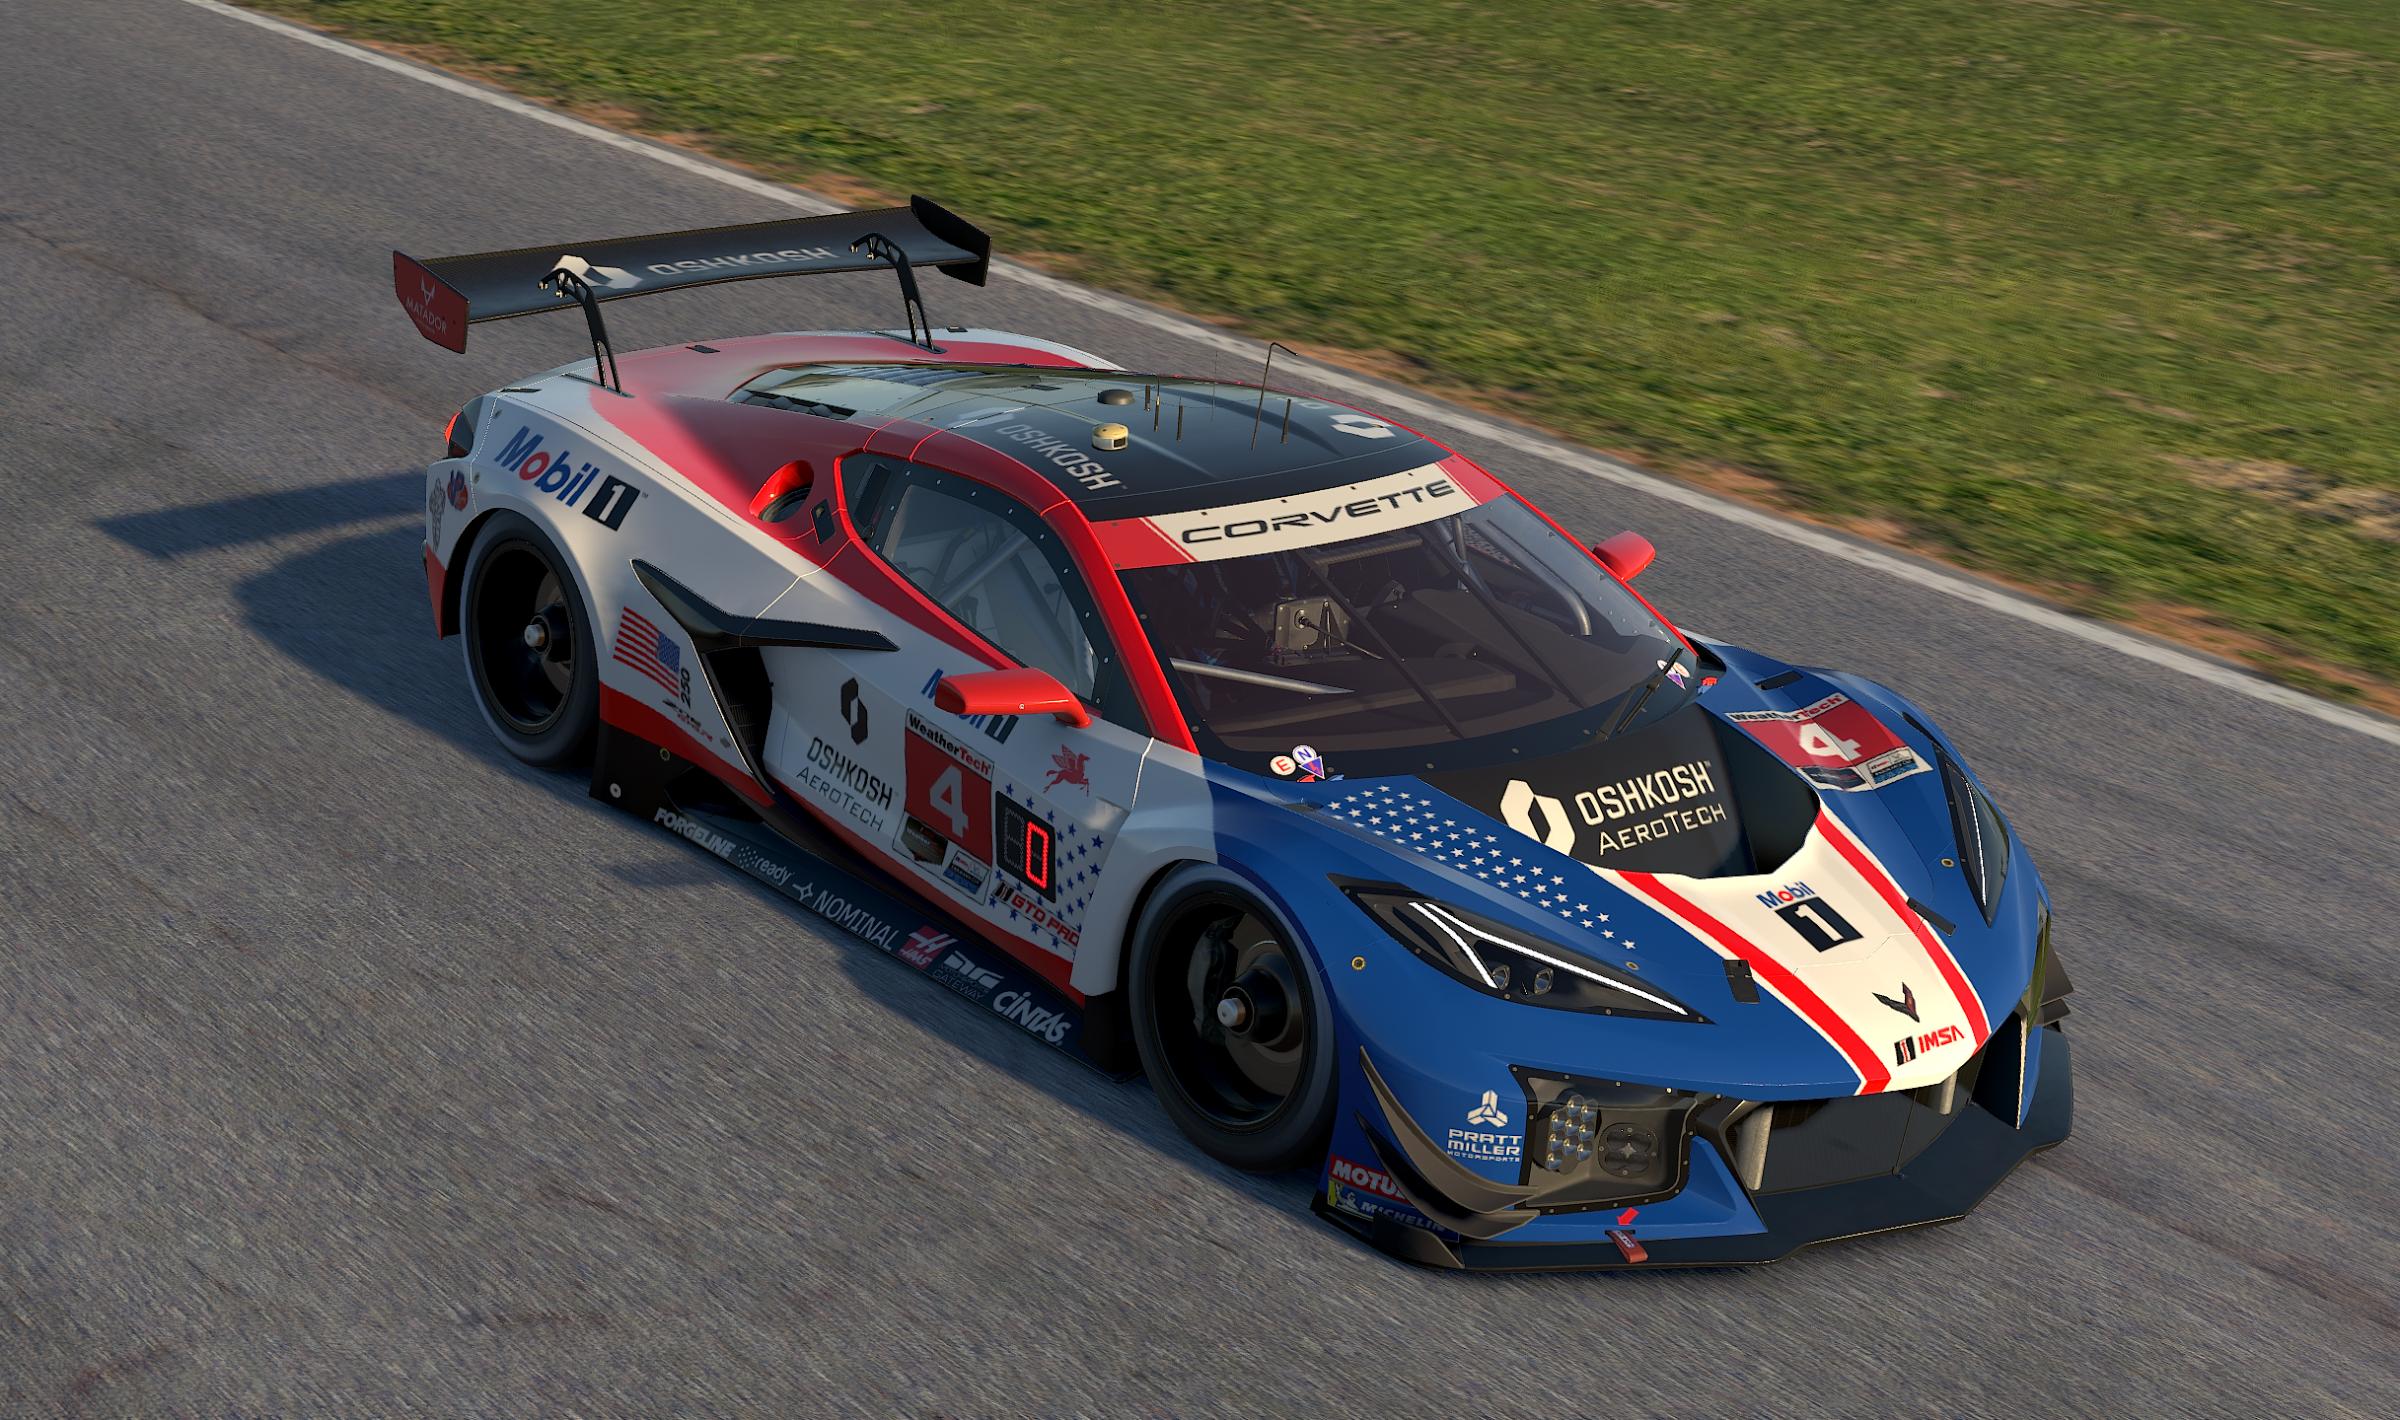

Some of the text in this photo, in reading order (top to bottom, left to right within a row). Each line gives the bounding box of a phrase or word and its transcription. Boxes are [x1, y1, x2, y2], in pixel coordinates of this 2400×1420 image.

[647, 247, 840, 275] OSHKOSH
[406, 297, 447, 335] MATADOR
[494, 426, 599, 507] Mobil
[997, 424, 1122, 491] OSHKOSH
[1182, 479, 1455, 544] CORVETTE
[909, 714, 990, 775] WeatherTech
[1798, 722, 1862, 761] 4
[807, 737, 893, 811] OSHKOSH
[1575, 761, 1715, 826] OSHKOSH
[929, 764, 969, 838] 4
[654, 807, 737, 859] FORGELINE
[755, 857, 791, 886] ready
[1756, 881, 1816, 909] Mobil
[812, 889, 900, 951] NOMINAL
[1012, 893, 1079, 946] GTD PRO
[1918, 1024, 1965, 1054] IMSA
[1447, 1140, 1521, 1156] MILLER
[1448, 1128, 1523, 1145] PRATT
